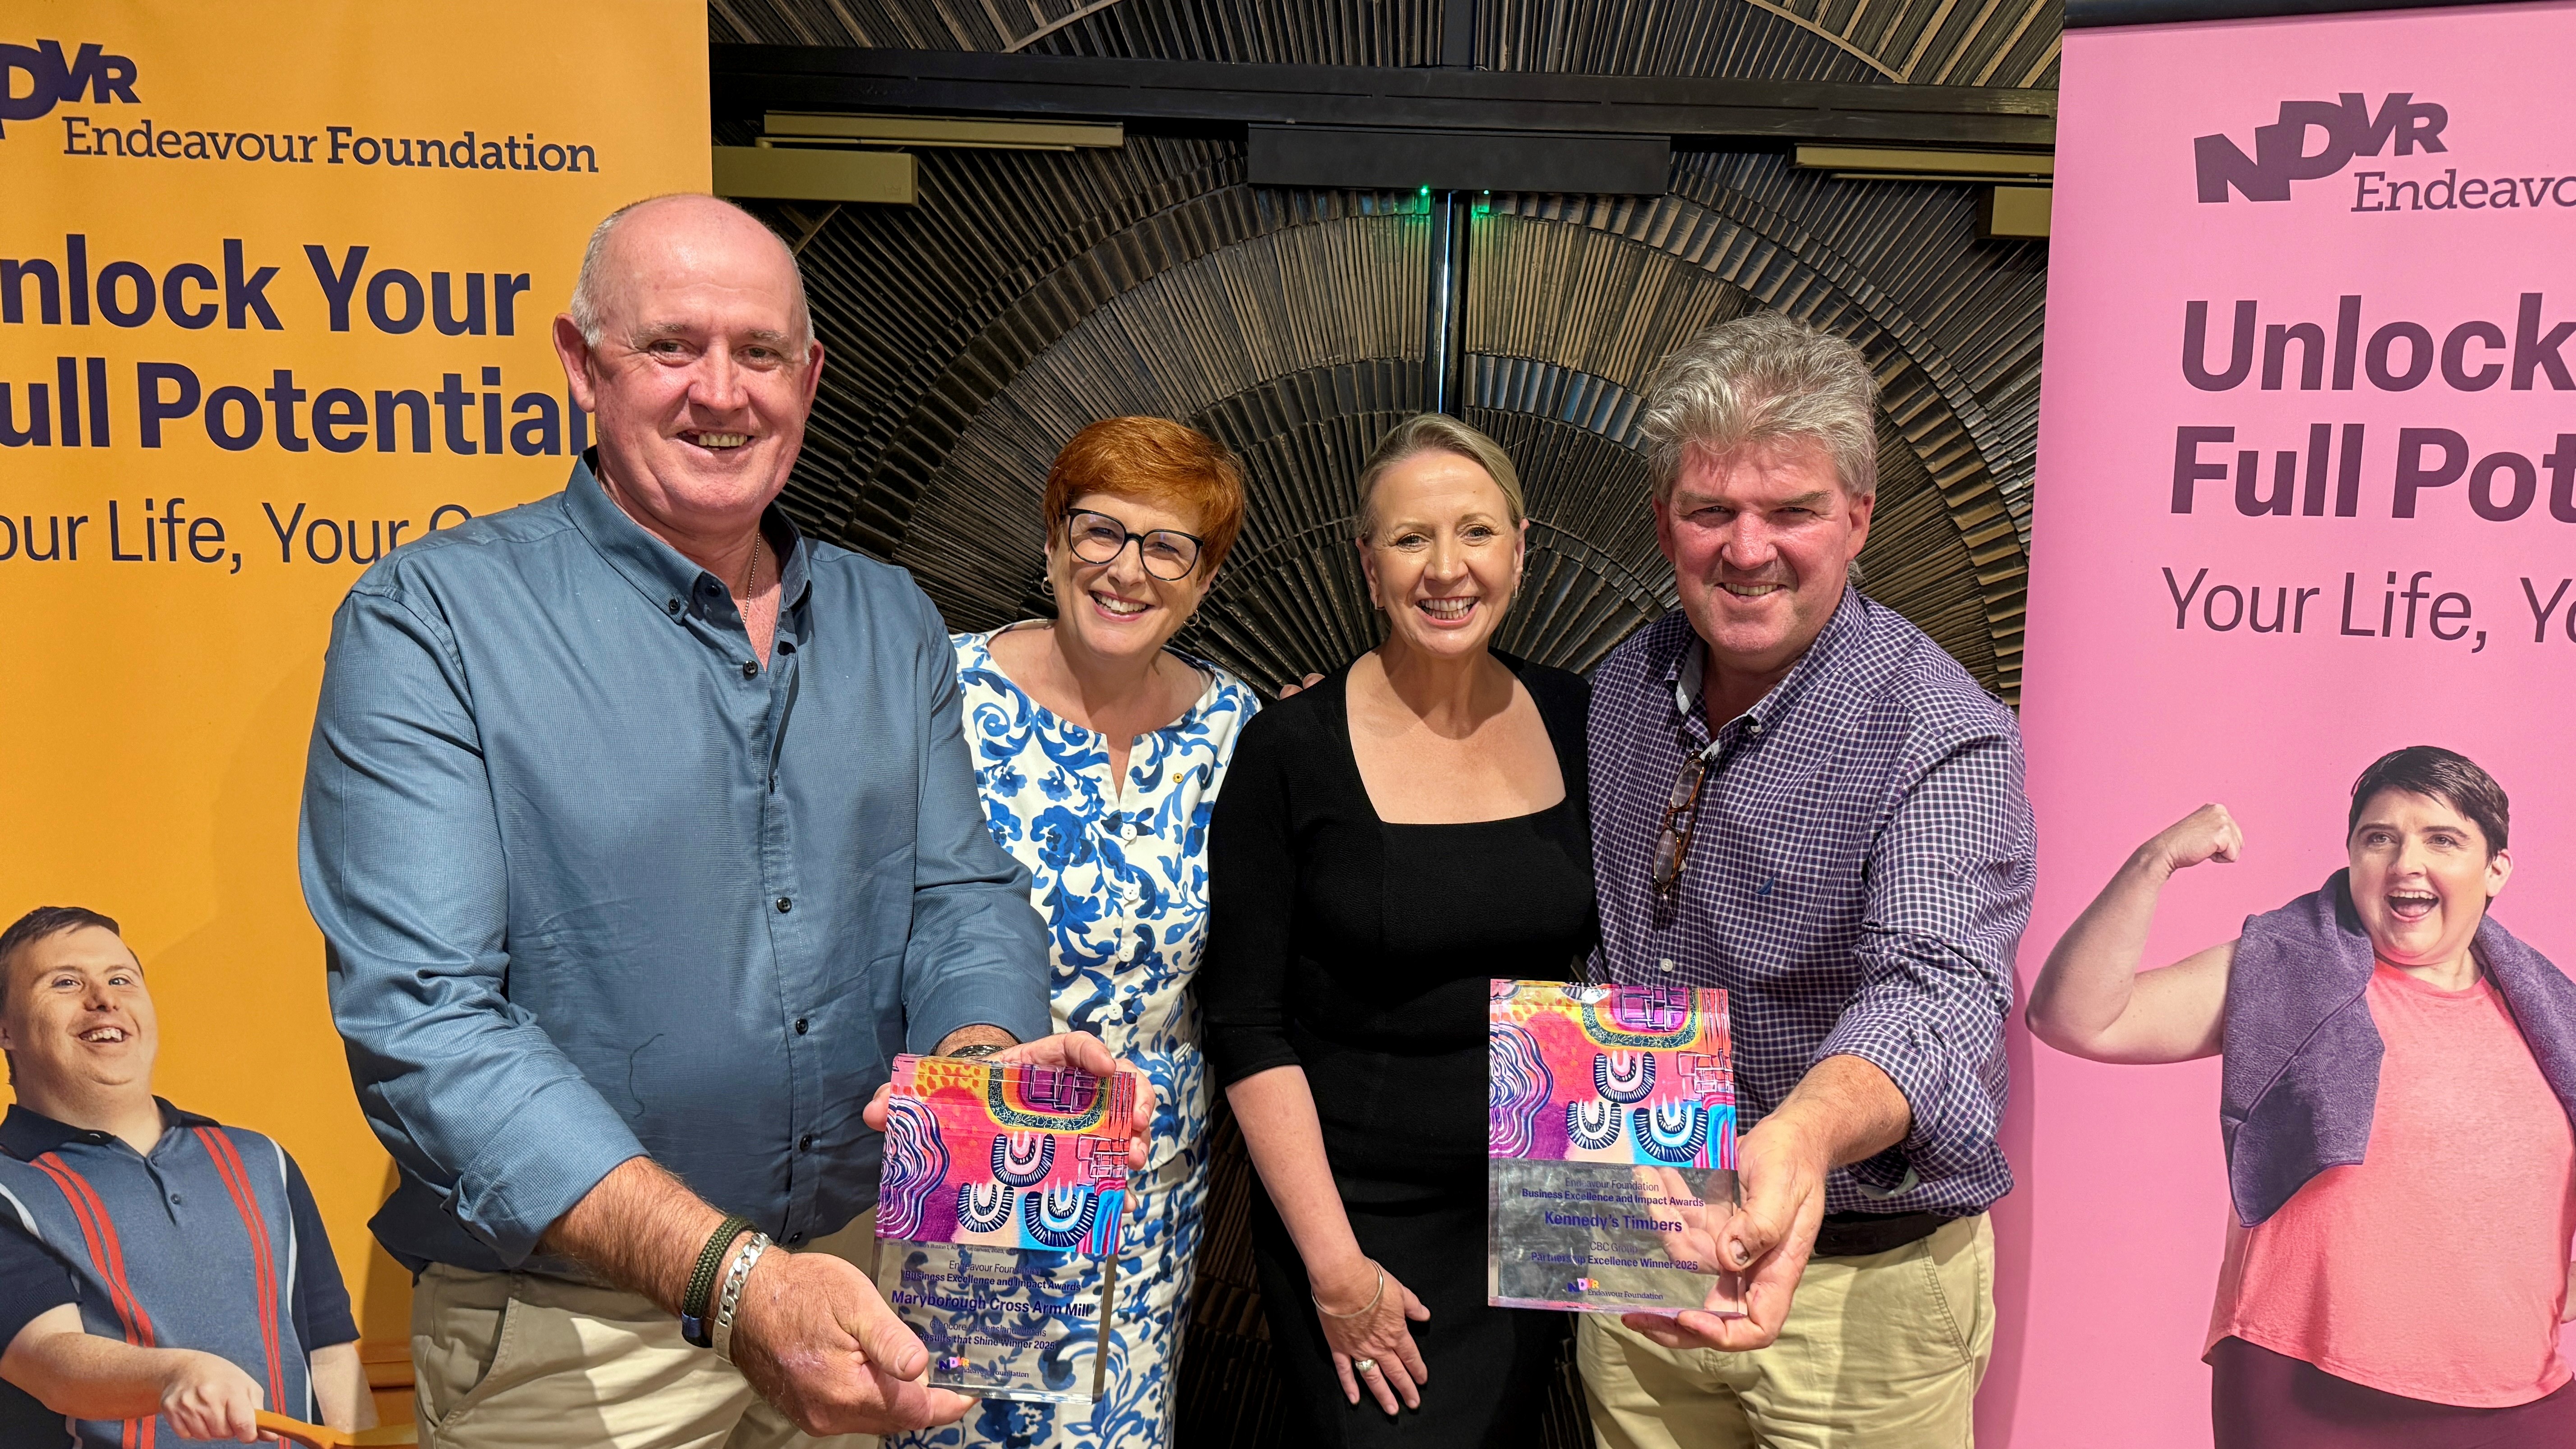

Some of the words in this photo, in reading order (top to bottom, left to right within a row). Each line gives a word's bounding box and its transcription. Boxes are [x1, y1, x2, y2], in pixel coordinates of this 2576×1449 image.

[0, 39, 142, 139] DVR
[62, 116, 318, 163] Endeavour
[326, 126, 599, 173] Foundation
[2194, 92, 2448, 203] NDVR
[303, 244, 530, 336] Your
[2182, 292, 2576, 392] Unlock
[137, 362, 588, 456] Potential
[2171, 423, 2365, 517] Full
[2392, 428, 2576, 524] Pot
[109, 497, 241, 575] Life,
[262, 502, 409, 564] Your
[2162, 567, 2320, 634] Your
[2340, 571, 2487, 653] Life,
[1522, 1188, 1563, 1198] Business
[1564, 1191, 1614, 1202] Excellence
[1616, 1195, 1633, 1203] and
[1635, 1195, 1667, 1206] Impact
[1669, 1196, 1704, 1207] Awards
[1612, 1180, 1659, 1191] Foundation
[1623, 1215, 1682, 1232] Timbers
[1590, 1241, 1609, 1251] CBC
[1611, 1243, 1638, 1255] Group
[949, 1260, 993, 1273] Endeavour
[1588, 1256, 1638, 1268] Excellence
[1640, 1258, 1673, 1269] Winner
[1675, 1260, 1698, 1270] 2025
[904, 1270, 945, 1282] Business
[947, 1273, 995, 1285] Excellence
[997, 1276, 1014, 1286] and
[1015, 1277, 1047, 1290] Impact
[1048, 1280, 1081, 1292] Awards
[1567, 1278, 1599, 1293] NDVR
[891, 1290, 986, 1312] Maryborough
[989, 1297, 1030, 1313] Cross
[1033, 1301, 1062, 1315] Arm
[1065, 1303, 1090, 1317] Mill
[1624, 1291, 1664, 1300] Foundation
[919, 1332, 951, 1343] Results
[953, 1334, 971, 1344] that
[974, 1336, 998, 1346] Shine
[1001, 1338, 1032, 1349] Winner
